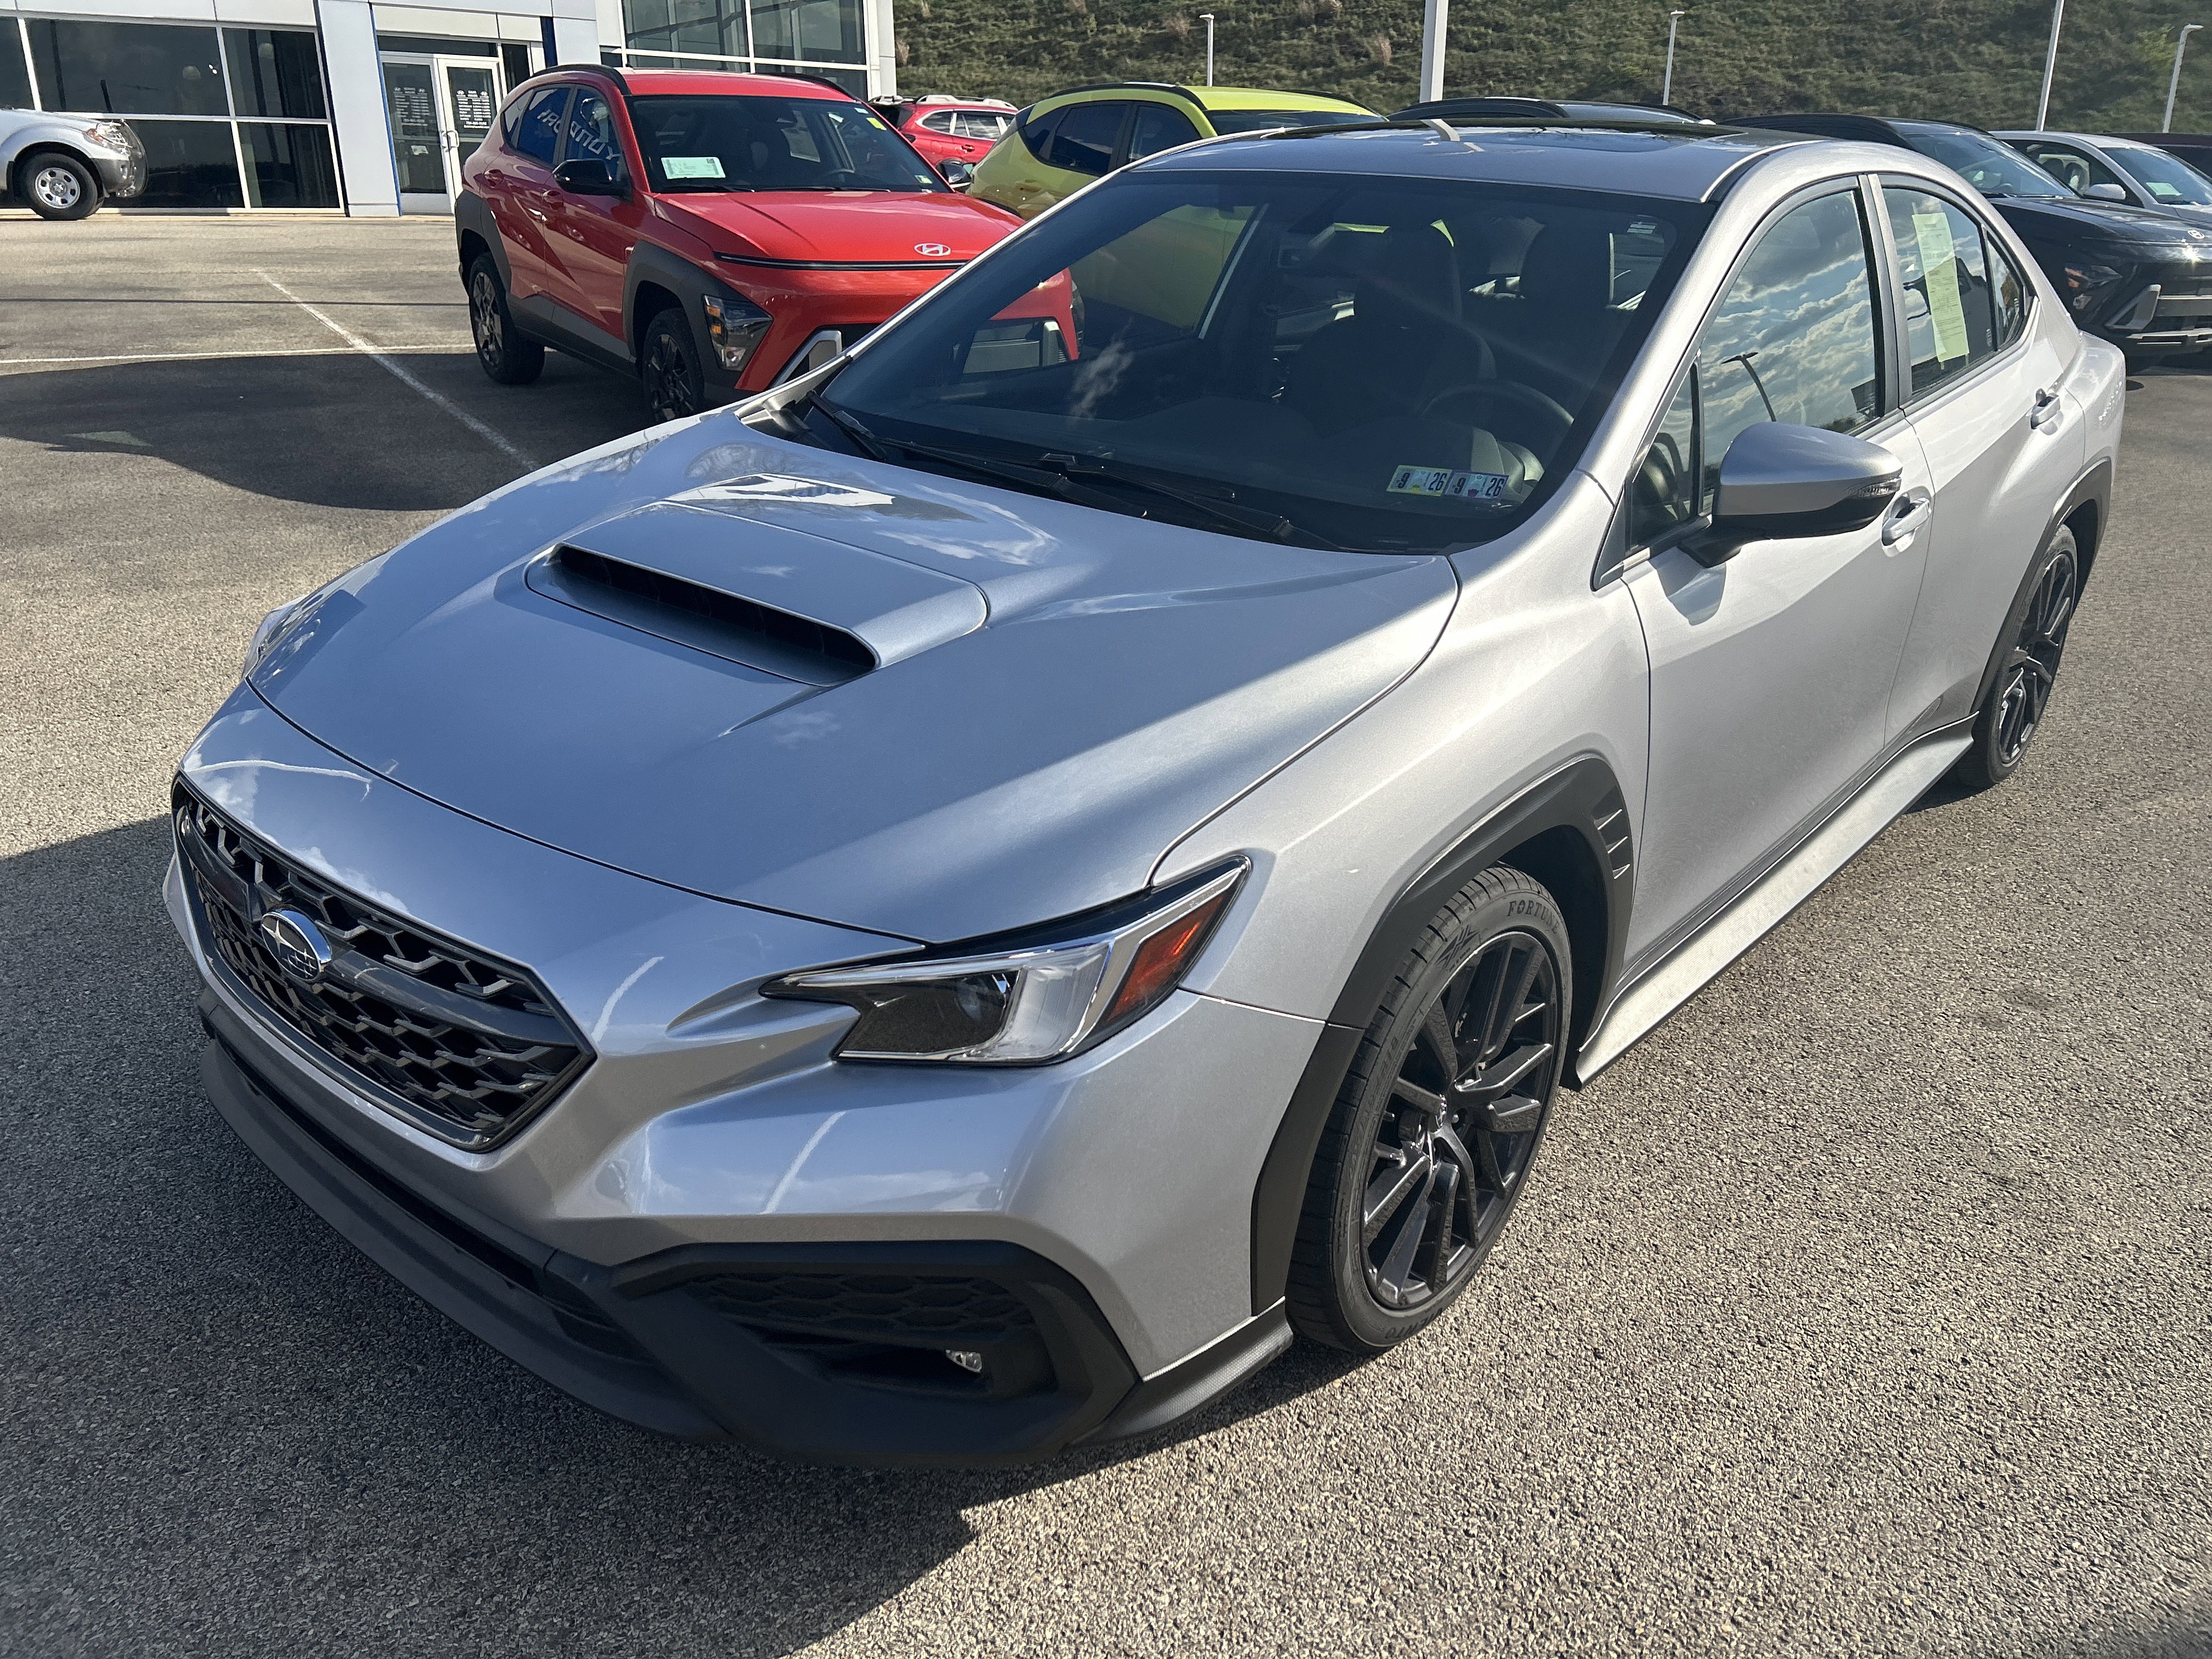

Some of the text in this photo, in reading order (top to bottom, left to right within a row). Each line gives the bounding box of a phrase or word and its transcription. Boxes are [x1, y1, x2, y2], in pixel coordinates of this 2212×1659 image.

[1398, 472, 1447, 491] 9 26
[1454, 477, 1505, 496] 9 26
[1506, 899, 1561, 934] FORTUNE
